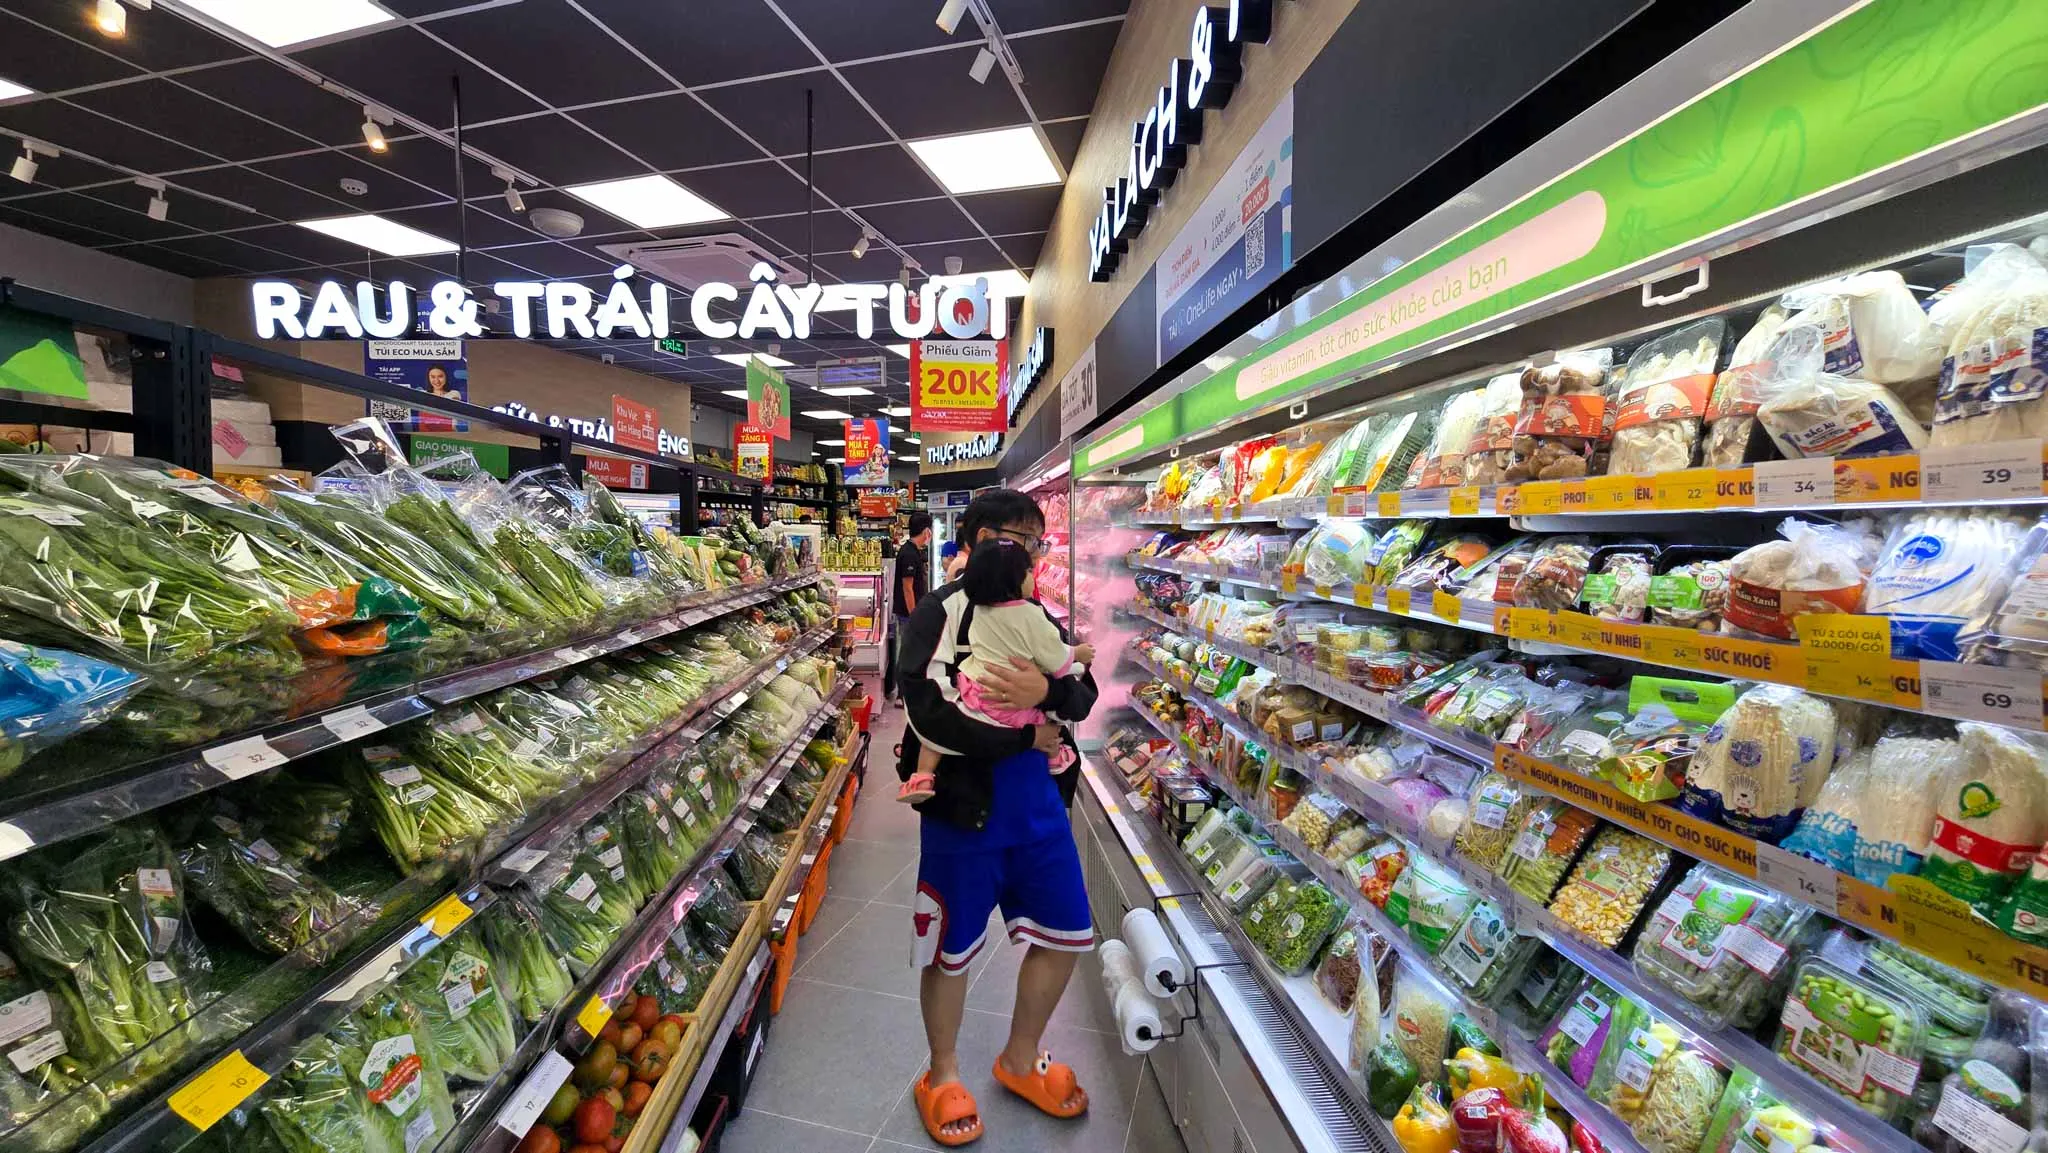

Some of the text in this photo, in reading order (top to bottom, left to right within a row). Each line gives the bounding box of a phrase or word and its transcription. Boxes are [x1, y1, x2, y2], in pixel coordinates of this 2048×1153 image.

[1113, 57, 1179, 239] LÁCH
[1188, 5, 1212, 110] &
[252, 280, 409, 339] RAU
[429, 280, 482, 338] &
[494, 264, 669, 339] TRÁI
[691, 261, 825, 339] CÂY
[1186, 288, 1216, 325] OneLife
[1216, 267, 1239, 302] NGAY
[1319, 337, 1336, 359] tốt
[1337, 327, 1360, 350] cho
[1362, 312, 1387, 340] sức
[1431, 274, 1463, 309] của
[1468, 256, 1508, 292] bạn
[375, 347, 390, 356] TÚI
[392, 348, 410, 356] ECO
[412, 348, 434, 356] MUA
[926, 343, 992, 357] Phiếu Giảm
[927, 368, 992, 397] 20K
[415, 440, 439, 451] GIAO
[848, 440, 869, 449] MUA 2
[926, 441, 955, 465] THỰC
[589, 460, 610, 472] MUA
[1982, 469, 2012, 485] 39
[1687, 488, 1702, 499] 22
[1793, 480, 1815, 493] 34
[1837, 629, 1859, 639] GÓI
[1861, 631, 1883, 641] GIÁ
[1674, 648, 1687, 658] 24
[1703, 646, 1730, 665] SỨC
[1856, 675, 1872, 686] 14
[1891, 675, 1921, 695] GU
[1982, 692, 2012, 709] 69
[247, 753, 265, 763] 32
[1560, 778, 1599, 802] PROTEIN
[1674, 823, 1702, 845] CHO
[1798, 876, 1817, 894] 14
[230, 1077, 248, 1088] 10
[524, 1100, 535, 1111] 17
